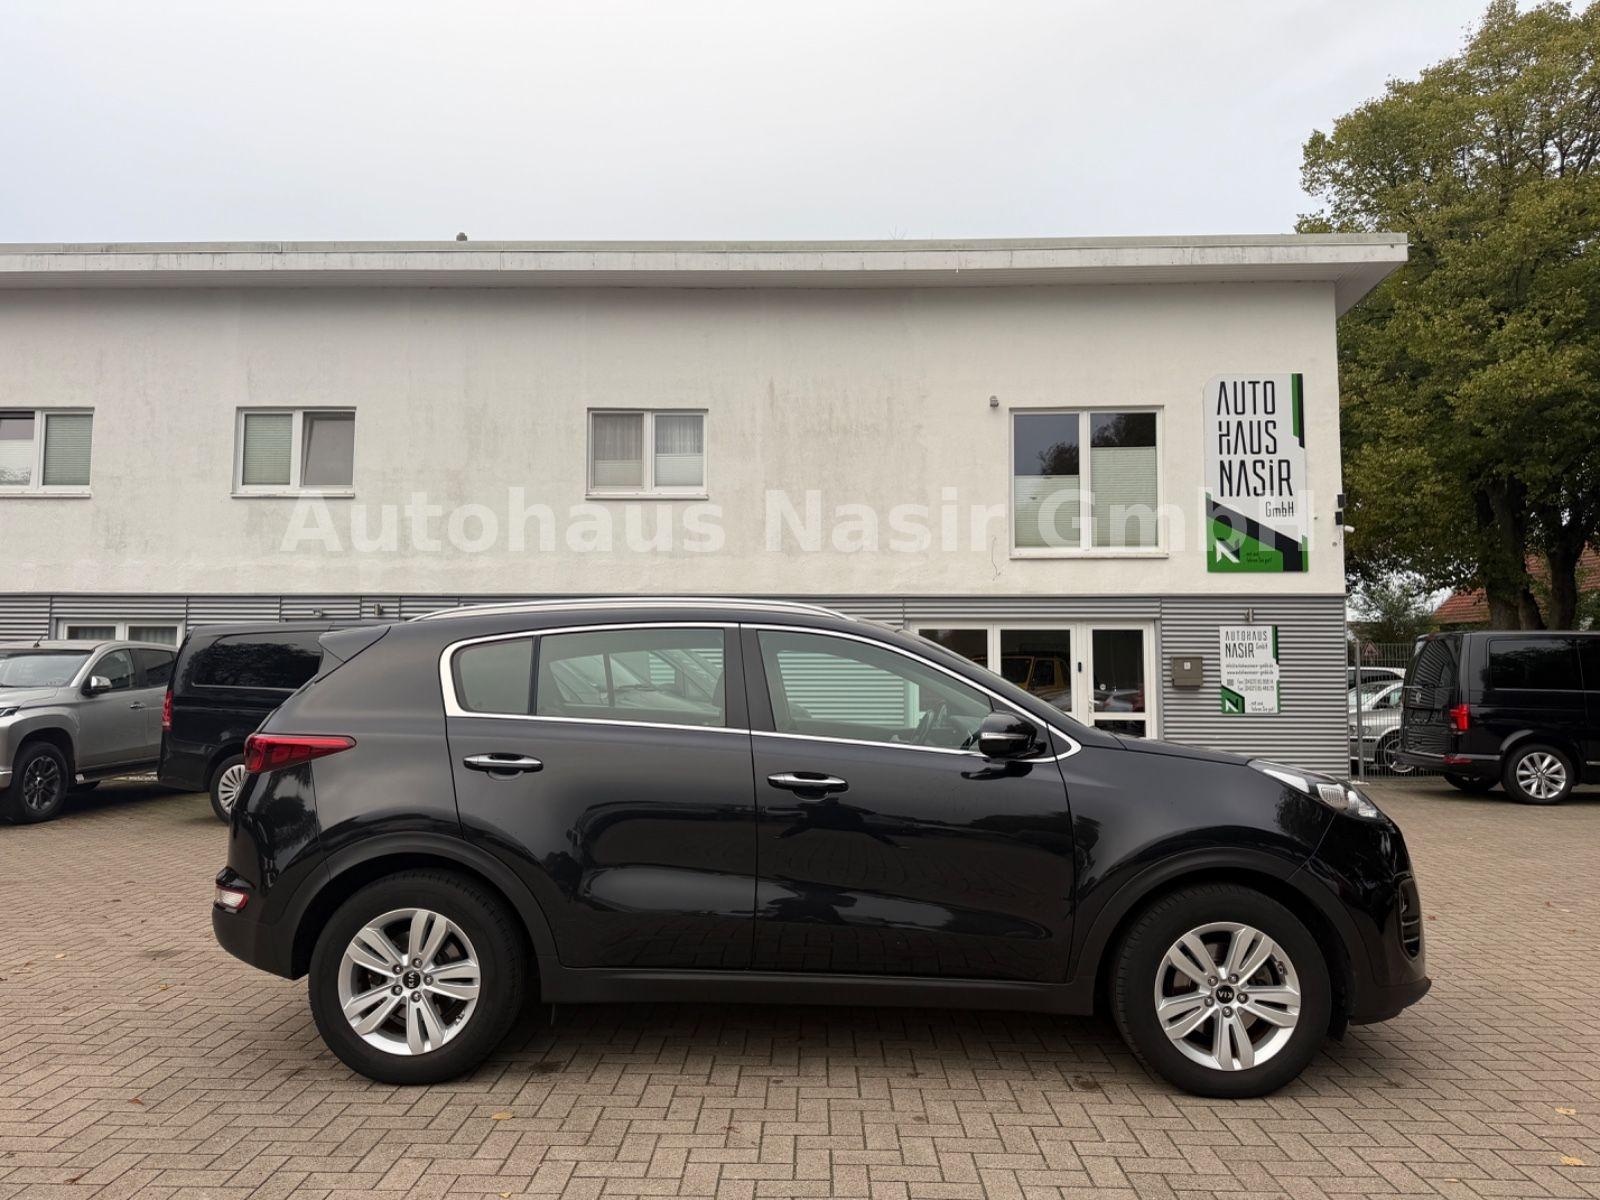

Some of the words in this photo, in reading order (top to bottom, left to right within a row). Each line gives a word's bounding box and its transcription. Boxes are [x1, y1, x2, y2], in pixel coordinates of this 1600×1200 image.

[1217, 381, 1276, 416] AUTO
[1218, 420, 1277, 455] HAUS
[1265, 501, 1295, 518] GmbH
[1225, 631, 1267, 641] AUTOHAUS
